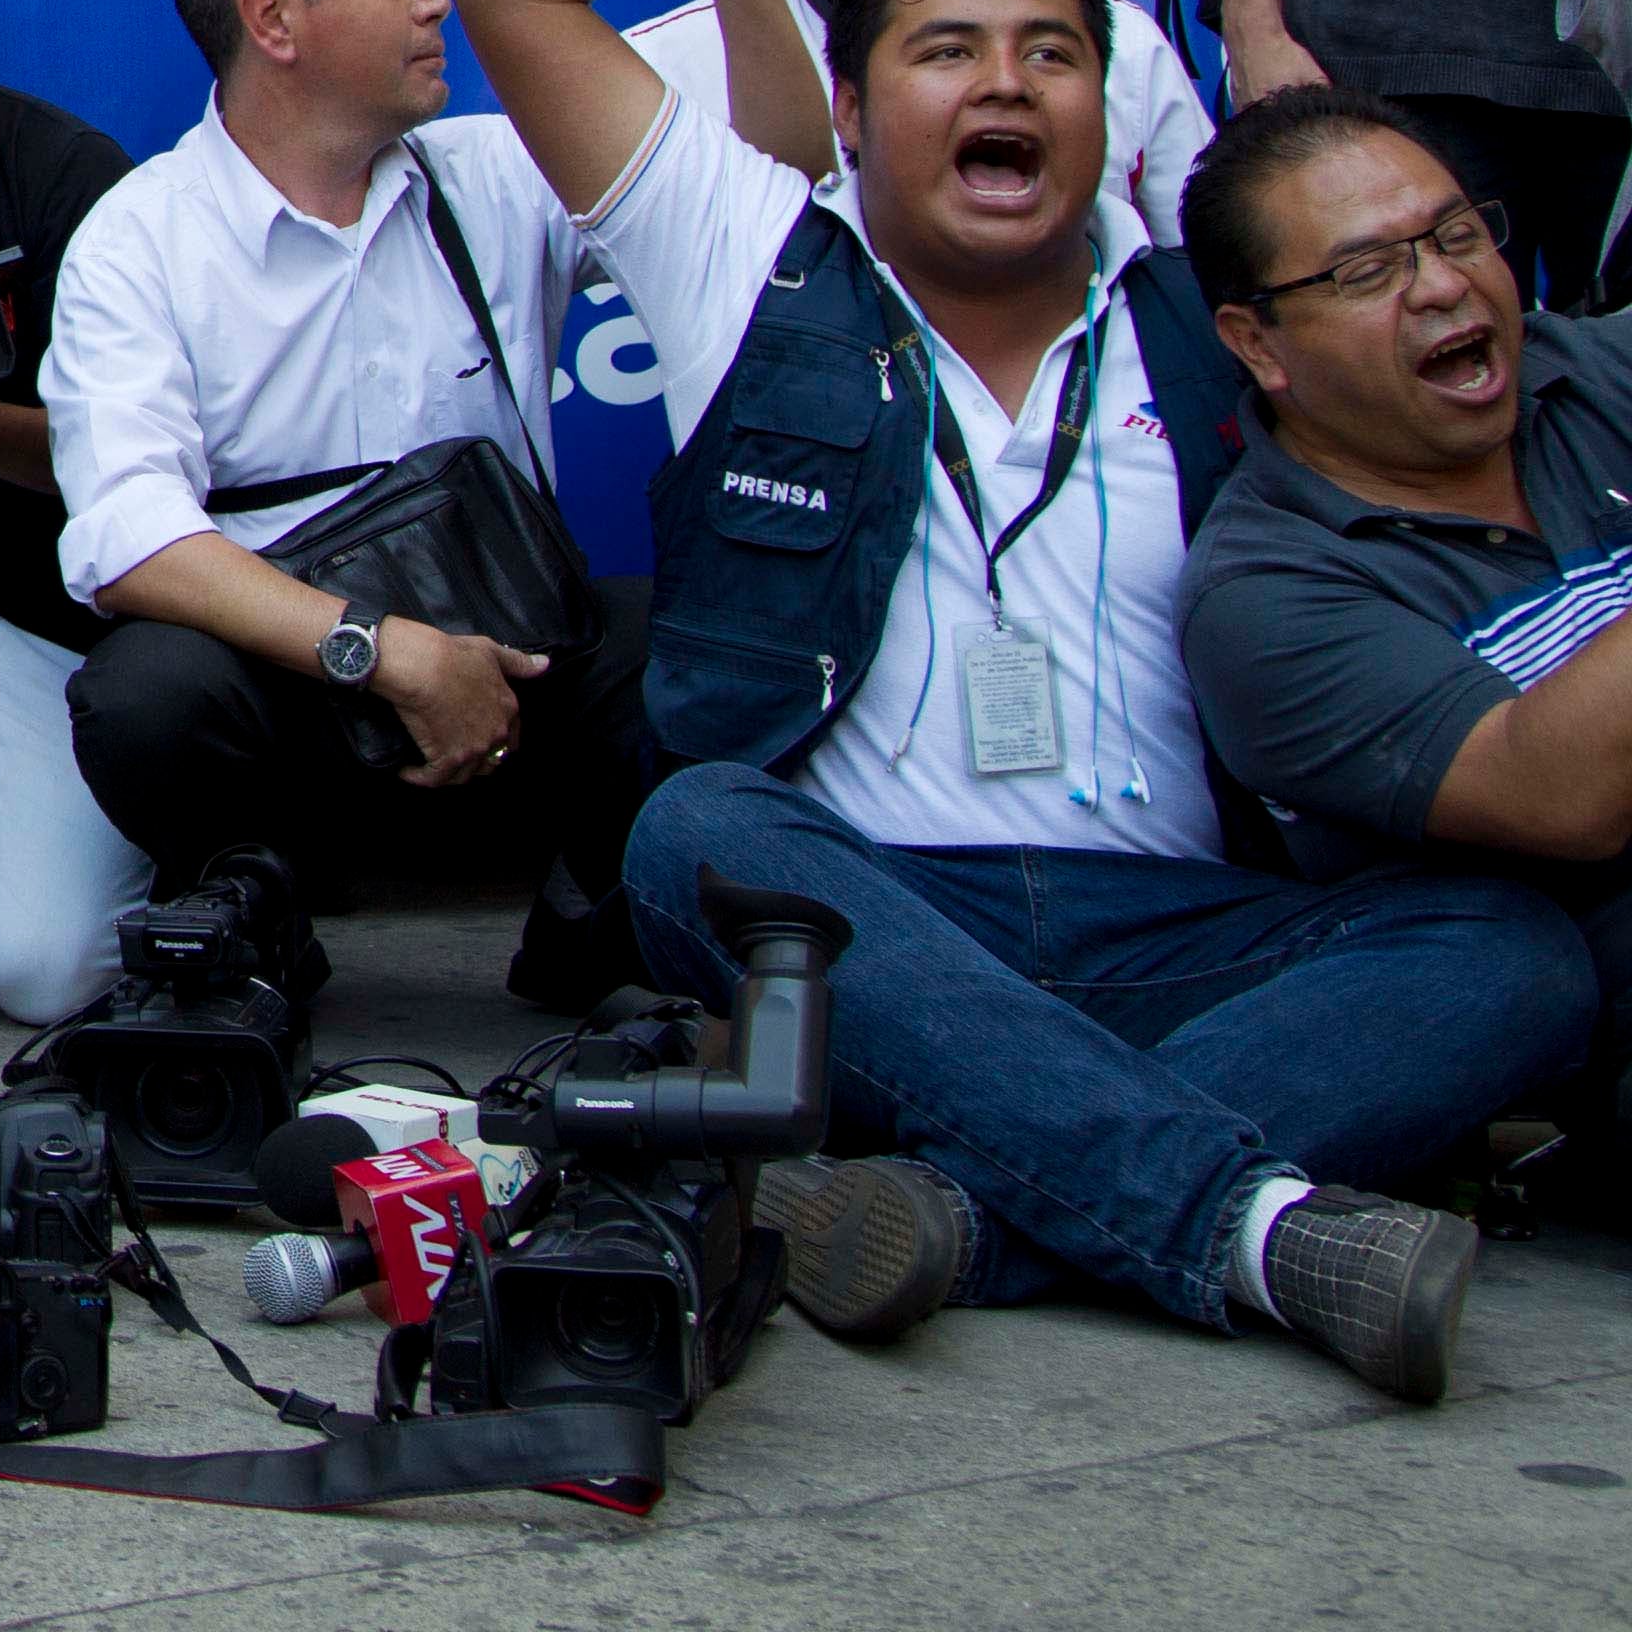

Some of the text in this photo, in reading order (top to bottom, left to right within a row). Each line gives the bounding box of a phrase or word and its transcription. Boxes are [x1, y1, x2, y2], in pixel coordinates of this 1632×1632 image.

[723, 470, 827, 511] PRENSA
[155, 939, 203, 949] Panasonic
[576, 1097, 634, 1109] Panasonic
